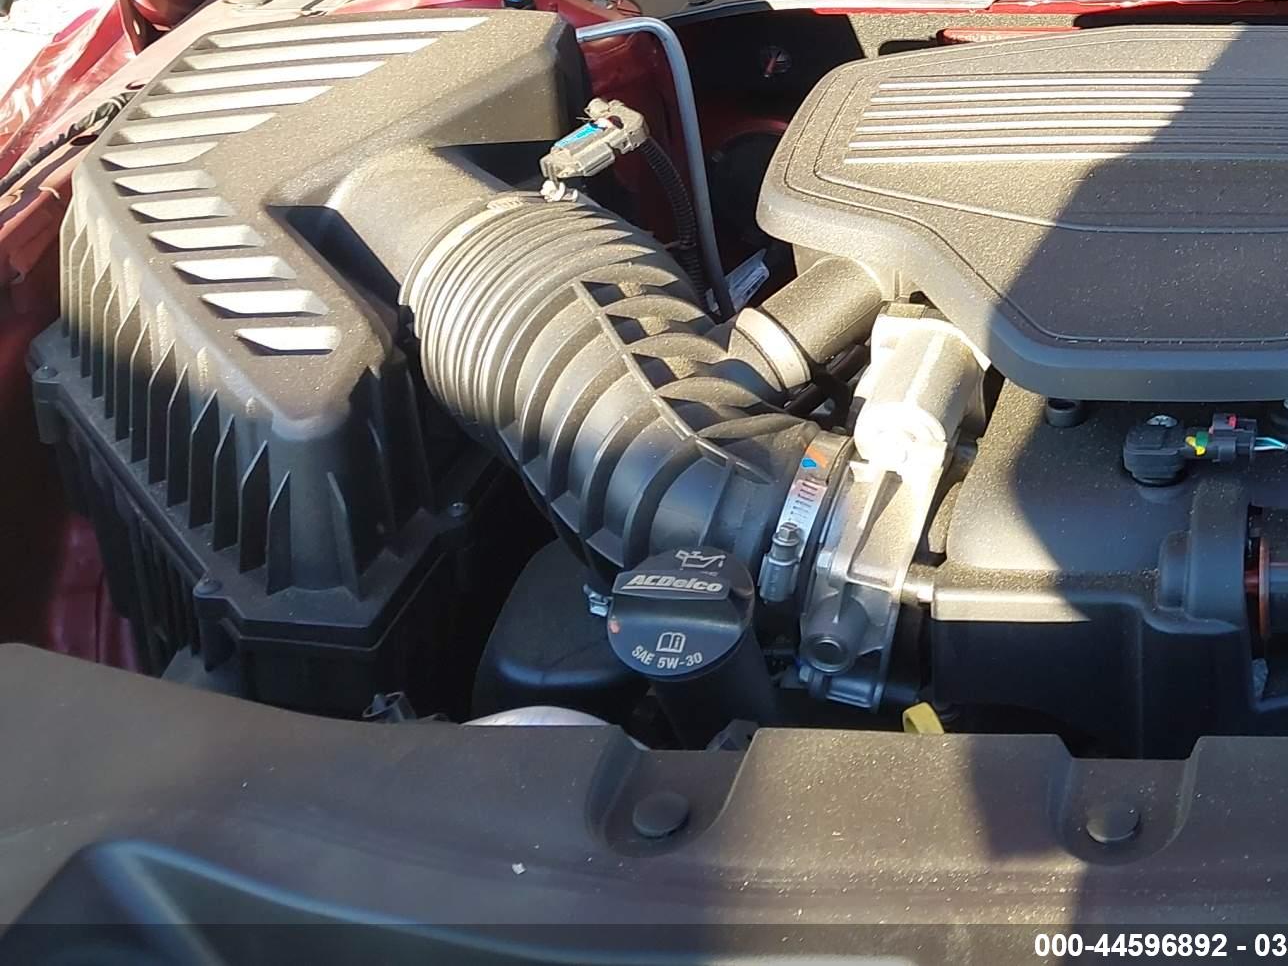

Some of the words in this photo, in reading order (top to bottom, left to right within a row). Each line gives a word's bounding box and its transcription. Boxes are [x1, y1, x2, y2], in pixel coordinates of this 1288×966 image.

[628, 574, 723, 593] ACDelco
[632, 645, 654, 666] SAE
[657, 652, 703, 669] 5W-30
